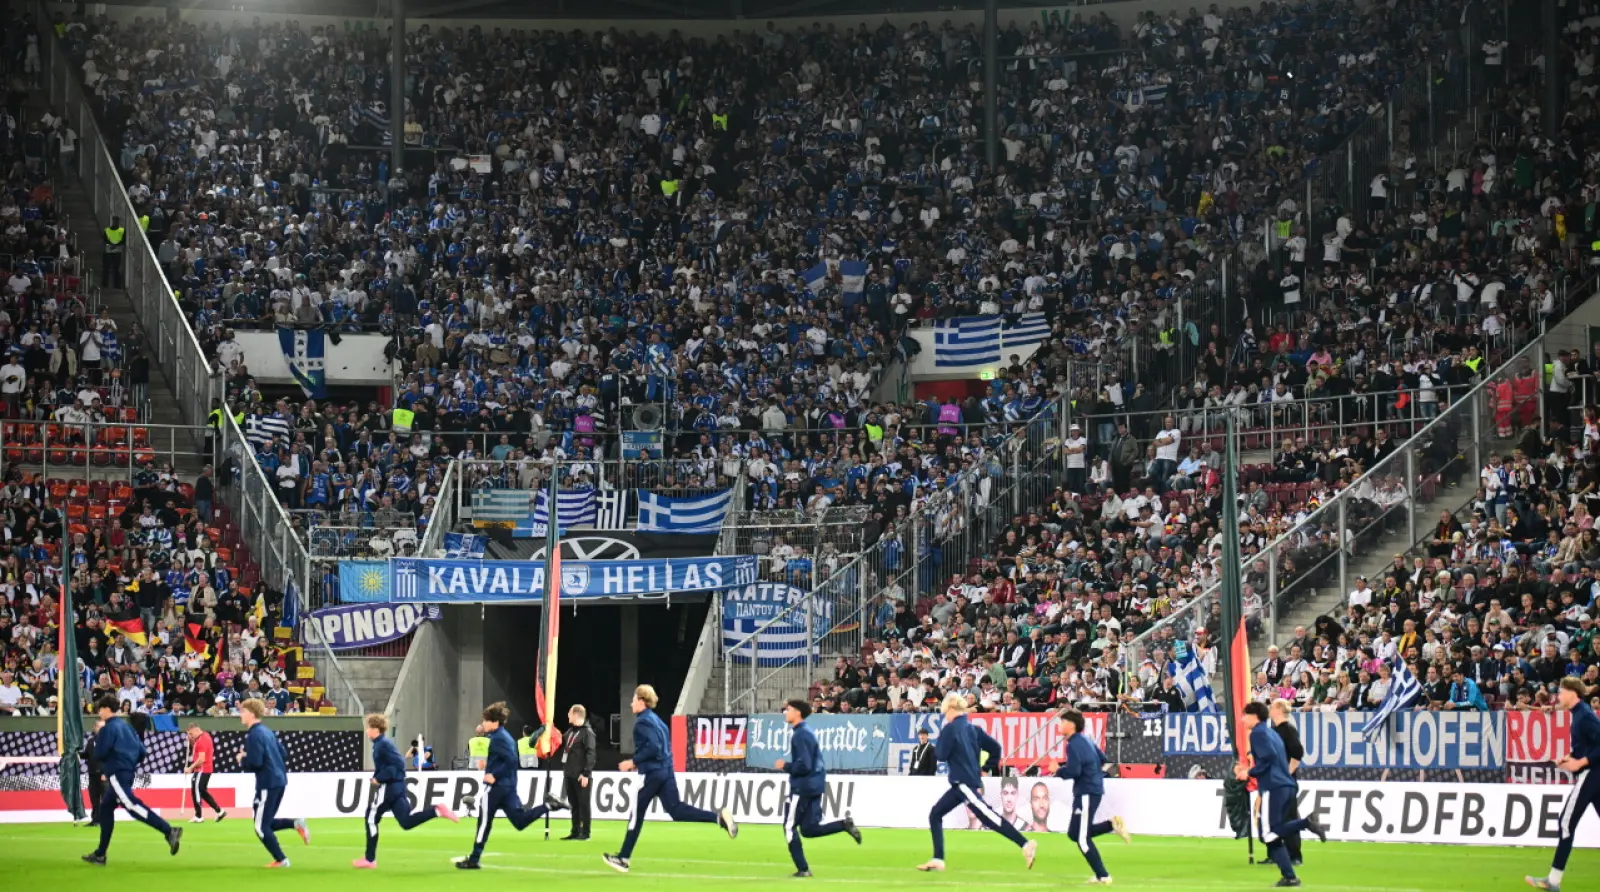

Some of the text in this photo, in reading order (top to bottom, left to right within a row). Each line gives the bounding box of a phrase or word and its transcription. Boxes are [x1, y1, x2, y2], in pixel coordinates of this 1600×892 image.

[428, 562, 723, 594] KAVALA HELLAS
[695, 717, 747, 757] DIEZ
[750, 718, 867, 757] Lichnrade
[1143, 718, 1162, 737] 13
[1215, 788, 1564, 838] TETS.DFB.DE
